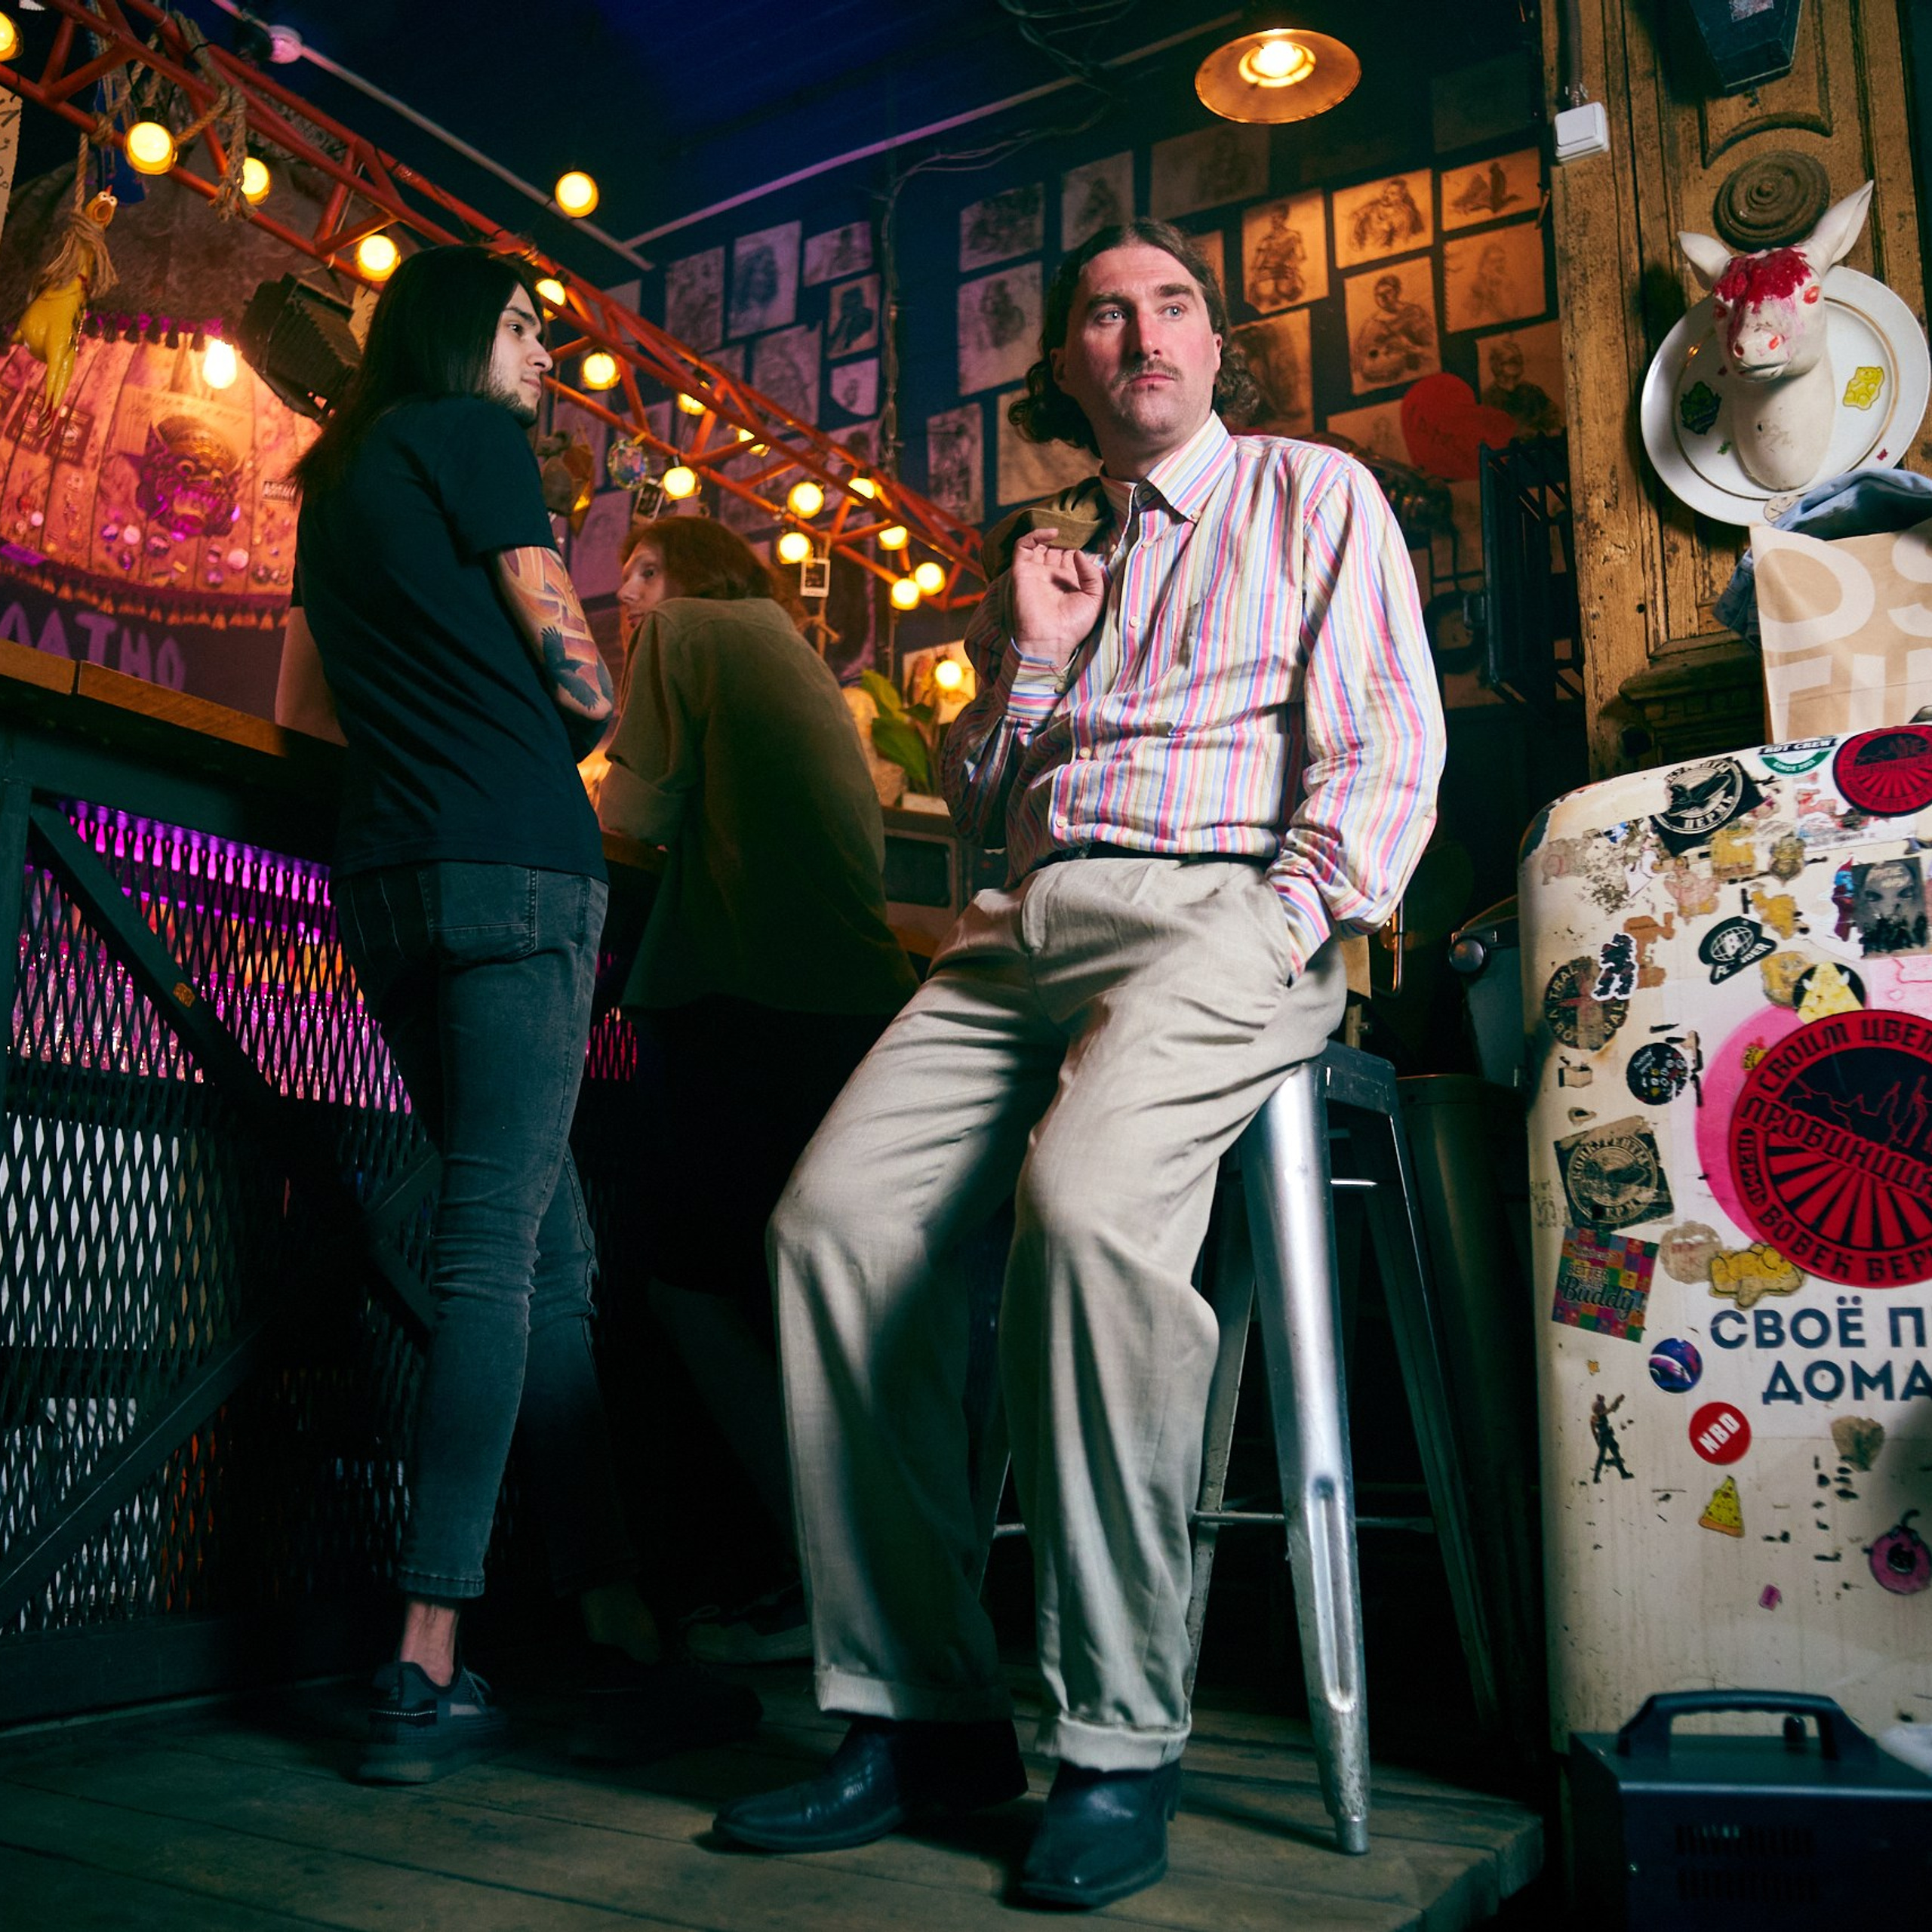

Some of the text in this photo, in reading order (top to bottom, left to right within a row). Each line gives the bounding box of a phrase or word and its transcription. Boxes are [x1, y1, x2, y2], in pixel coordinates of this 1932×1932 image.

[1684, 795, 1735, 829] ПЕРМЬ
[1758, 1023, 1850, 1093] СВОИМ
[1758, 1204, 1932, 1281] ВОВЕК ВЕР
[1559, 1275, 1635, 1321] Buddy
[1710, 1295, 1866, 1349] СВОЁ
[1762, 1359, 1932, 1405] ДОМА
[1699, 1412, 1741, 1455] NBD
